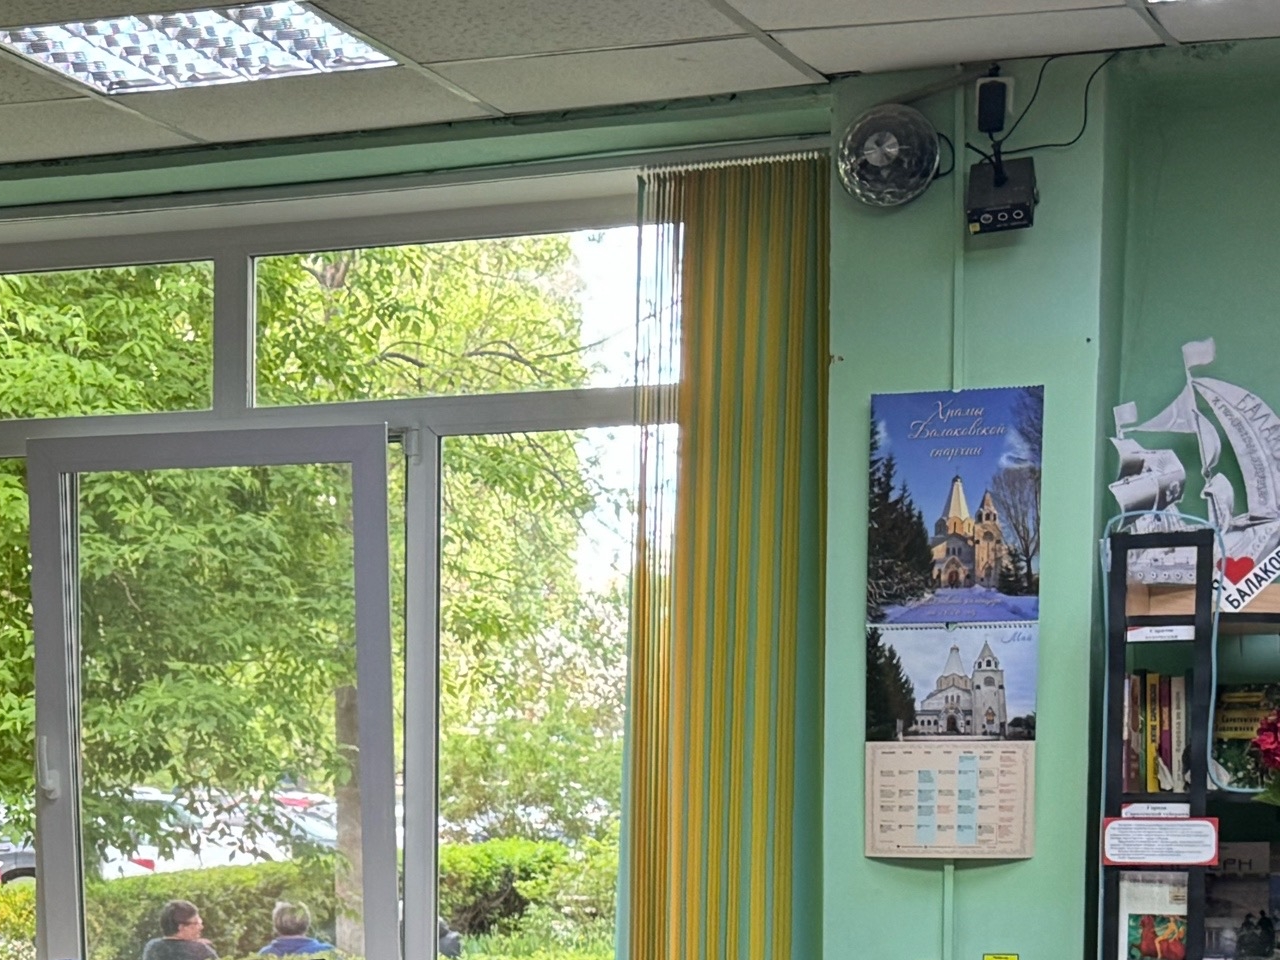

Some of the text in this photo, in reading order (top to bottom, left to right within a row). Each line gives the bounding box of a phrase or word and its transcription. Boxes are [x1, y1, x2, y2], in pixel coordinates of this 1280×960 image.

[928, 400, 984, 423] Храмы
[907, 417, 1007, 439] Балаковской
[929, 446, 983, 461] епархии
